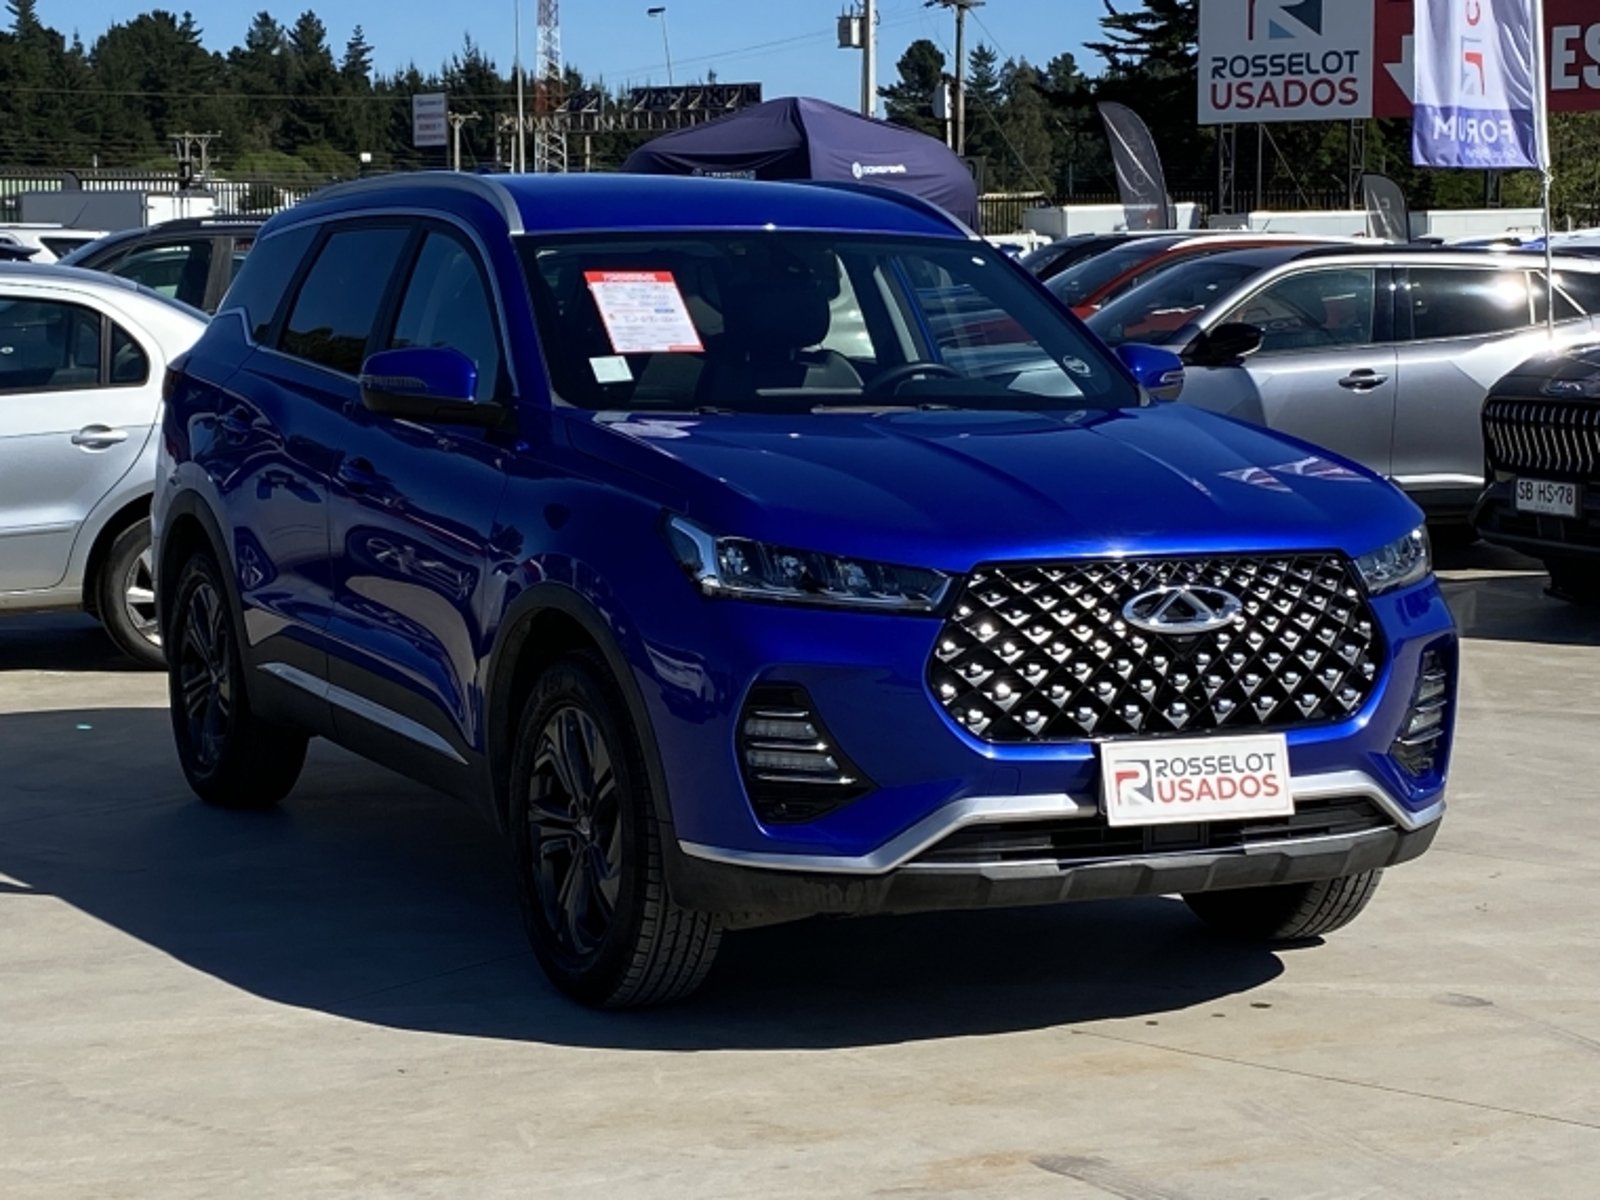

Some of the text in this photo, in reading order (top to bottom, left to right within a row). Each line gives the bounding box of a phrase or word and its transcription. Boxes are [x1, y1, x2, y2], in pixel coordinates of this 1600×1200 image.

[1211, 49, 1360, 79] ROSSELOT
[1211, 77, 1359, 110] USADOS
[1518, 481, 1533, 501] SB
[1154, 753, 1276, 777] ROSSELOT
[1156, 774, 1280, 804] USADOS
